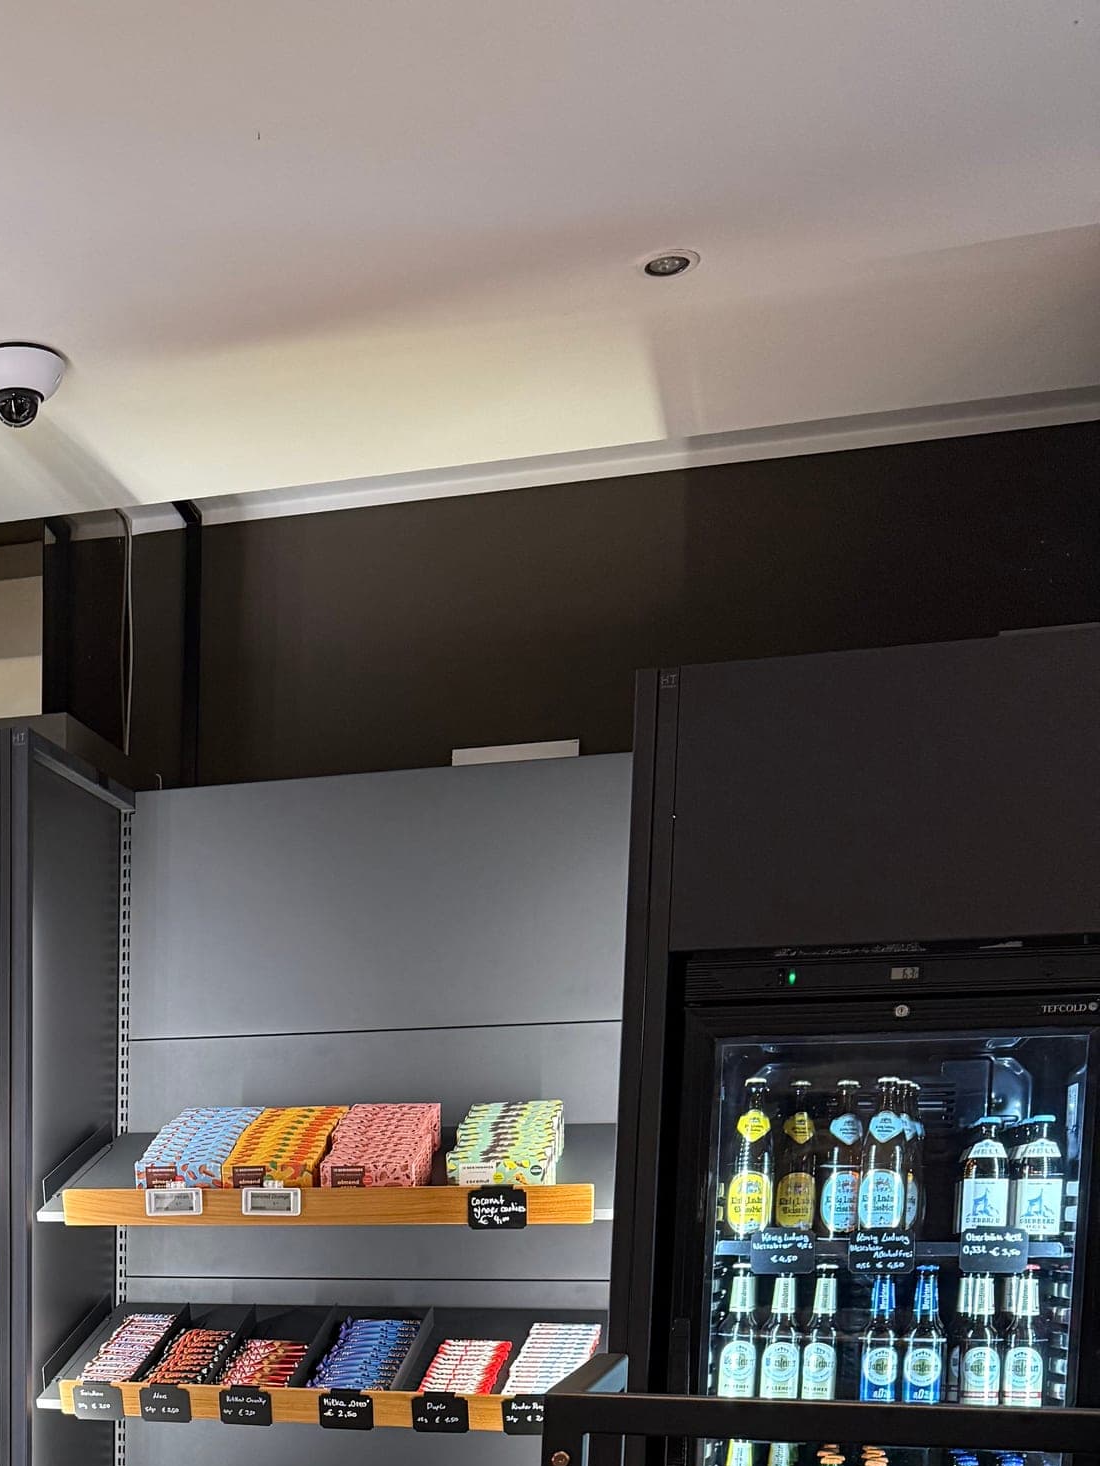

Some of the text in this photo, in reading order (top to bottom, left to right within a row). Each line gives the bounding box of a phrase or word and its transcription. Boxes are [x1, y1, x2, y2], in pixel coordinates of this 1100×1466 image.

[1041, 1003, 1087, 1013] TEFCOLD
[881, 1233, 911, 1244] Ludwig
[324, 1398, 346, 1407] Milka
[338, 1410, 357, 1418] 2,50
